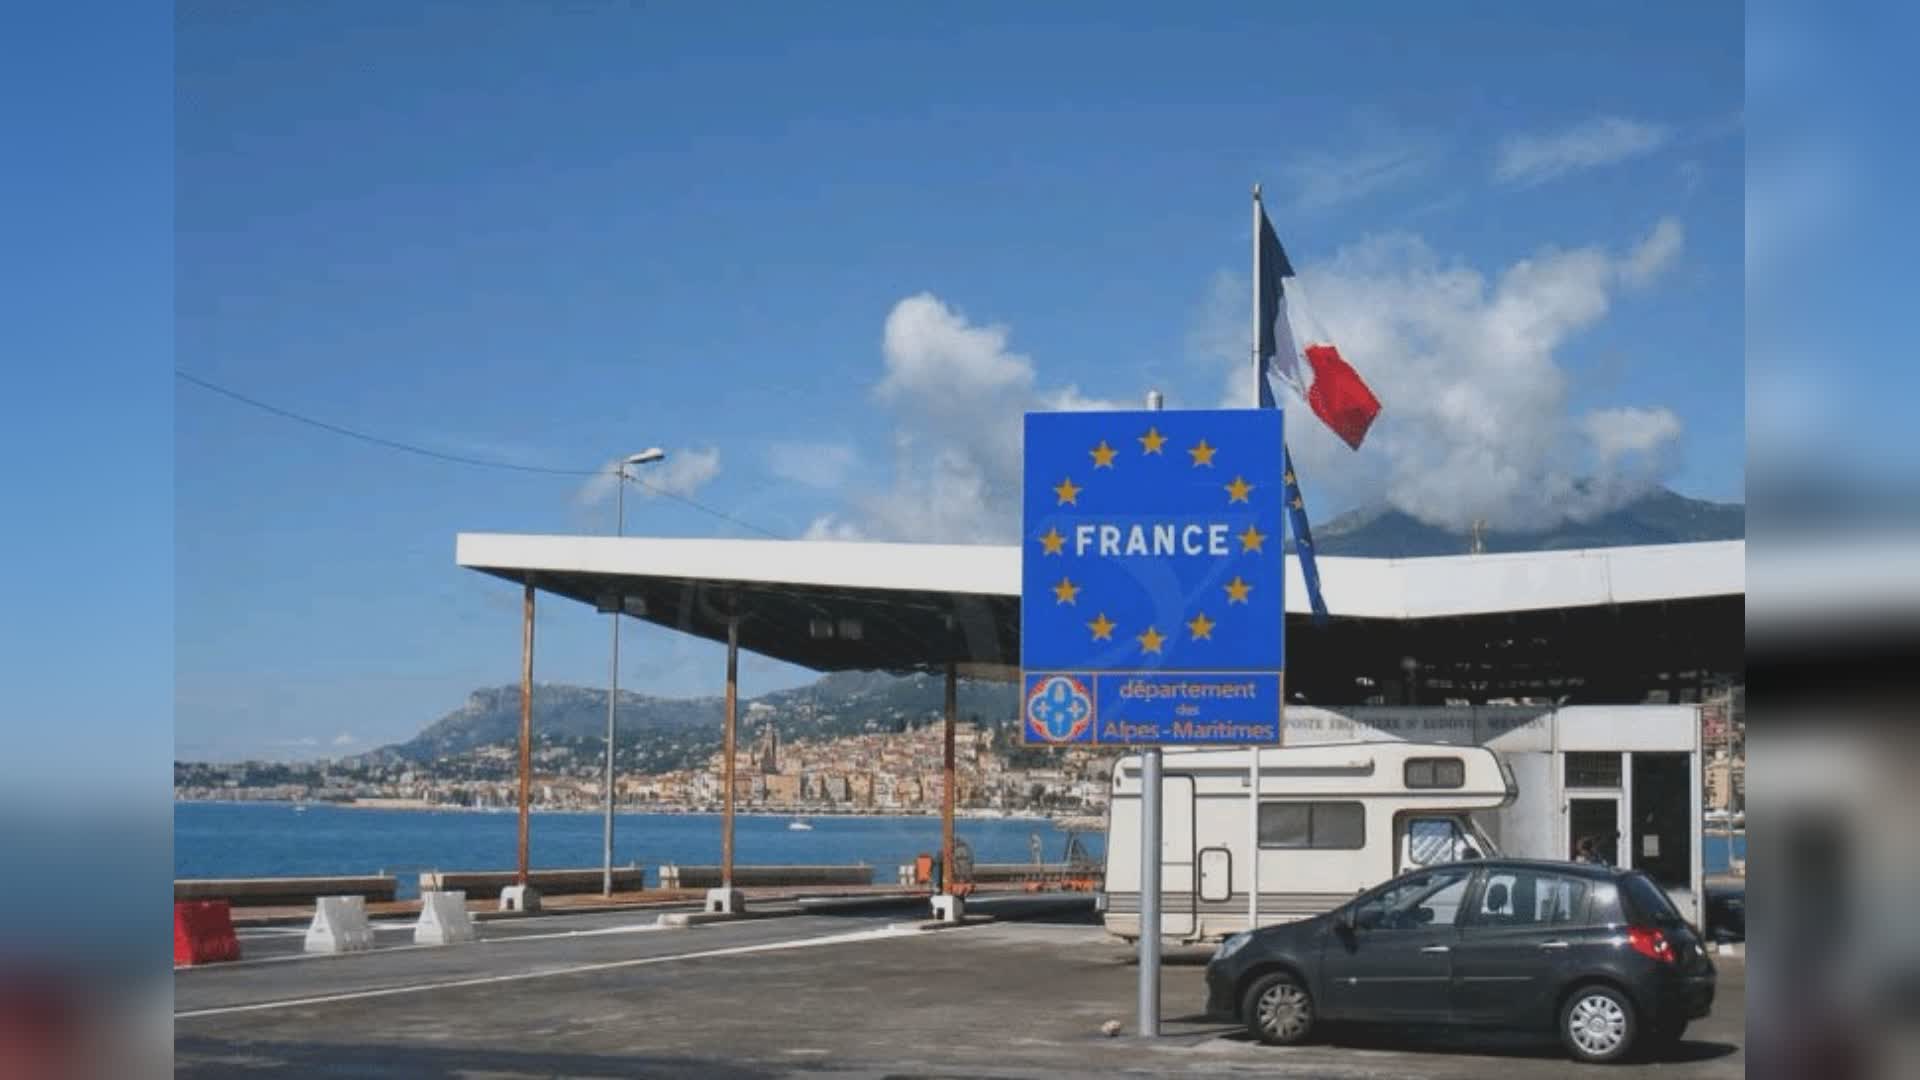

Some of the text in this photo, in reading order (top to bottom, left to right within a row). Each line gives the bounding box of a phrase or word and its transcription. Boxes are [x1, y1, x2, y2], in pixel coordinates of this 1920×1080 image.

[1075, 524, 1230, 556] FRANCE
[1119, 679, 1256, 702] département
[1175, 703, 1200, 716] des
